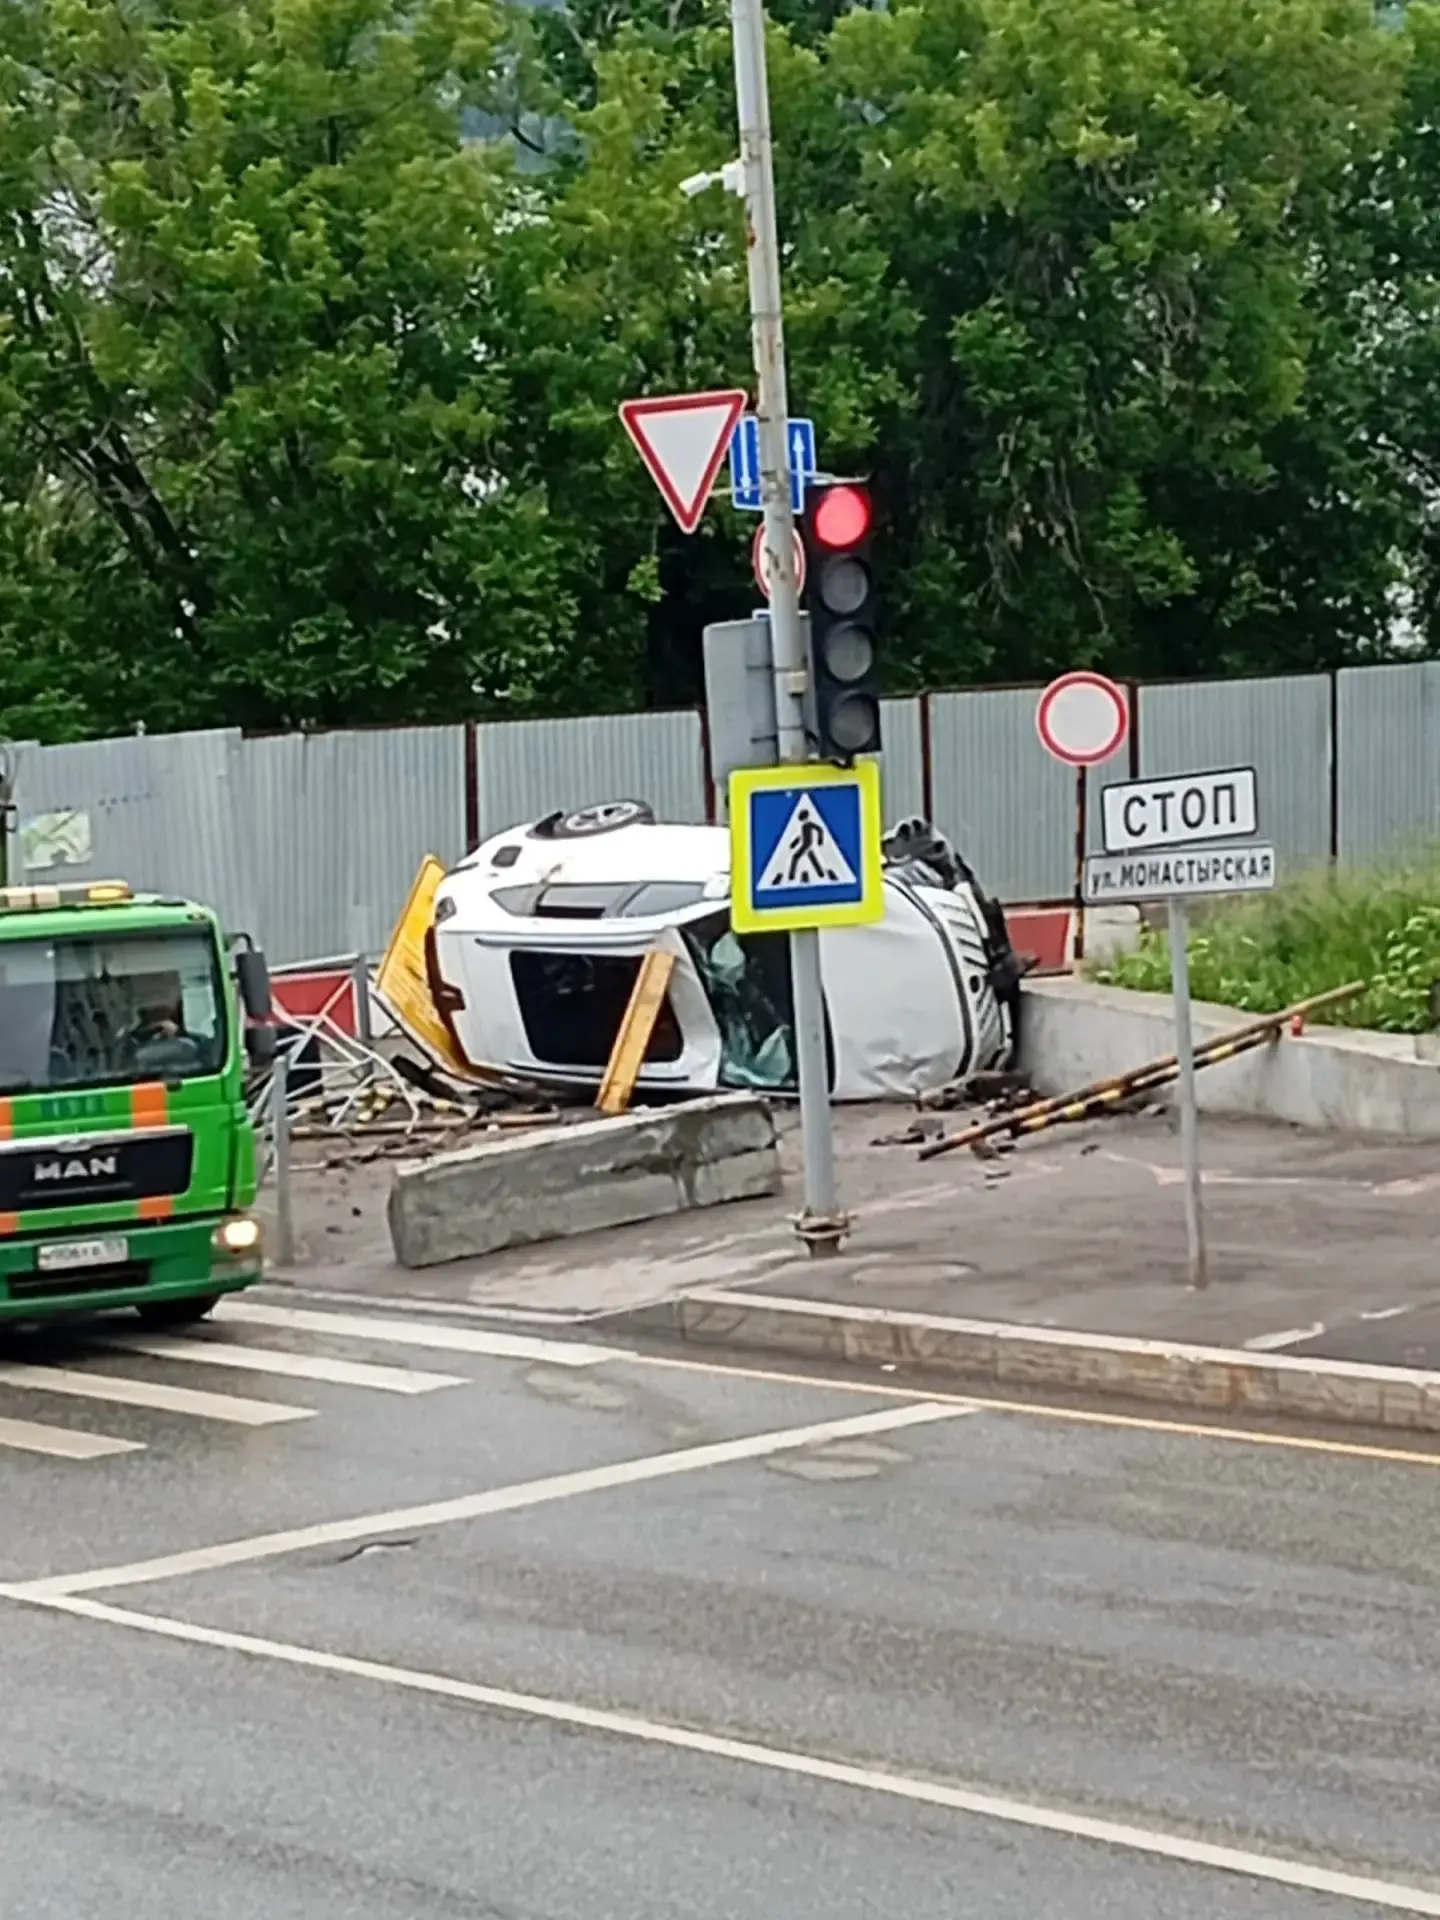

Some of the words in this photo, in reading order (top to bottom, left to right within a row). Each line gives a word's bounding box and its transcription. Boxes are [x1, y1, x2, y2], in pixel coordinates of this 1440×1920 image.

[1123, 784, 1237, 838] СТОП
[1090, 871, 1117, 895] ул.
[1119, 855, 1271, 888] МОНАСТЫРСКАЯ
[34, 1156, 117, 1181] MAN
